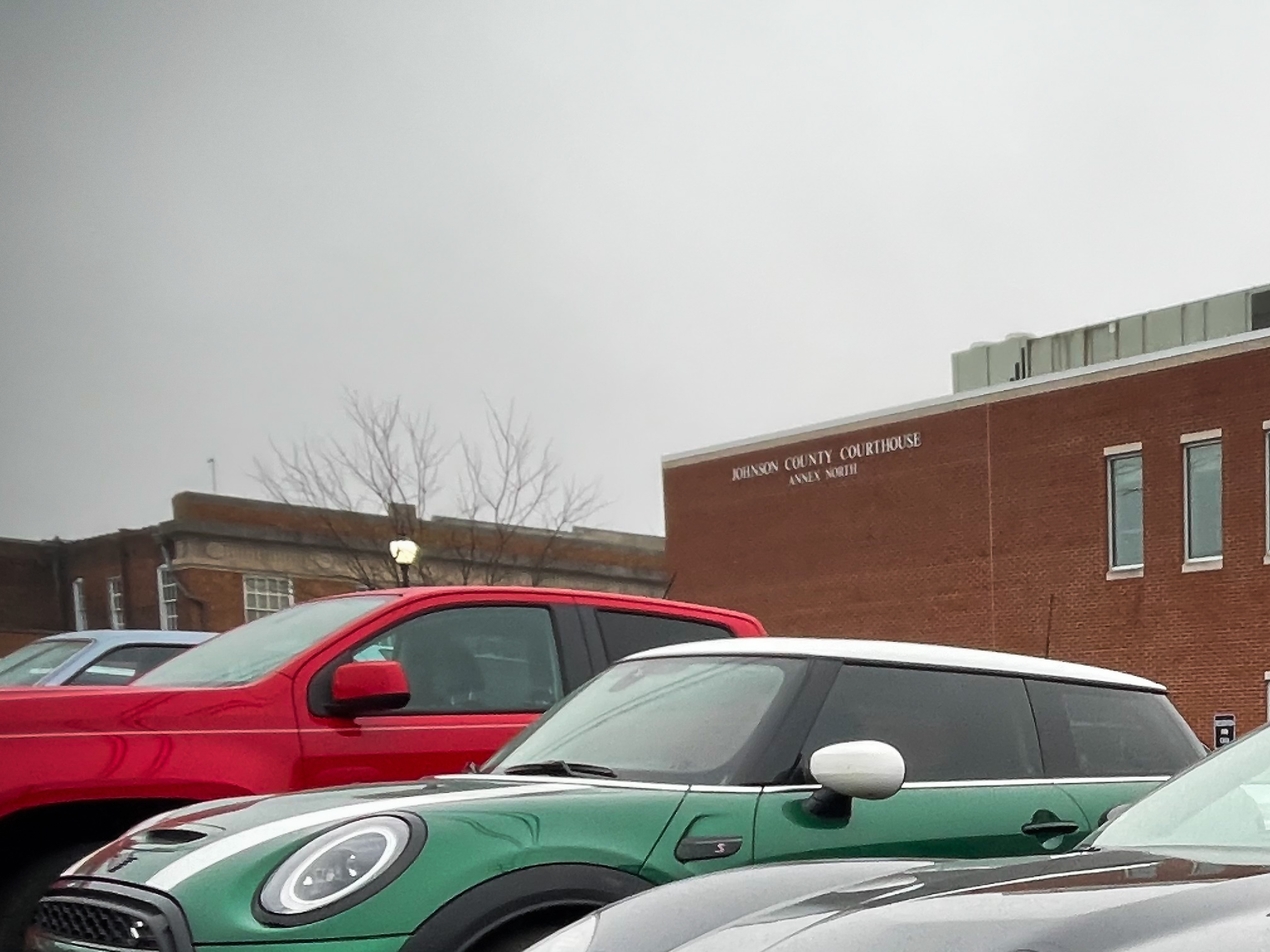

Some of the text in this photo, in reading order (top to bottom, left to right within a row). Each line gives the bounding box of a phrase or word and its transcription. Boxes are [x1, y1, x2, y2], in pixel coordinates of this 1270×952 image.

[732, 432, 922, 481] JOHNSON COUNTY COURTHOUSE
[789, 463, 858, 486] ANNEX NORTH
